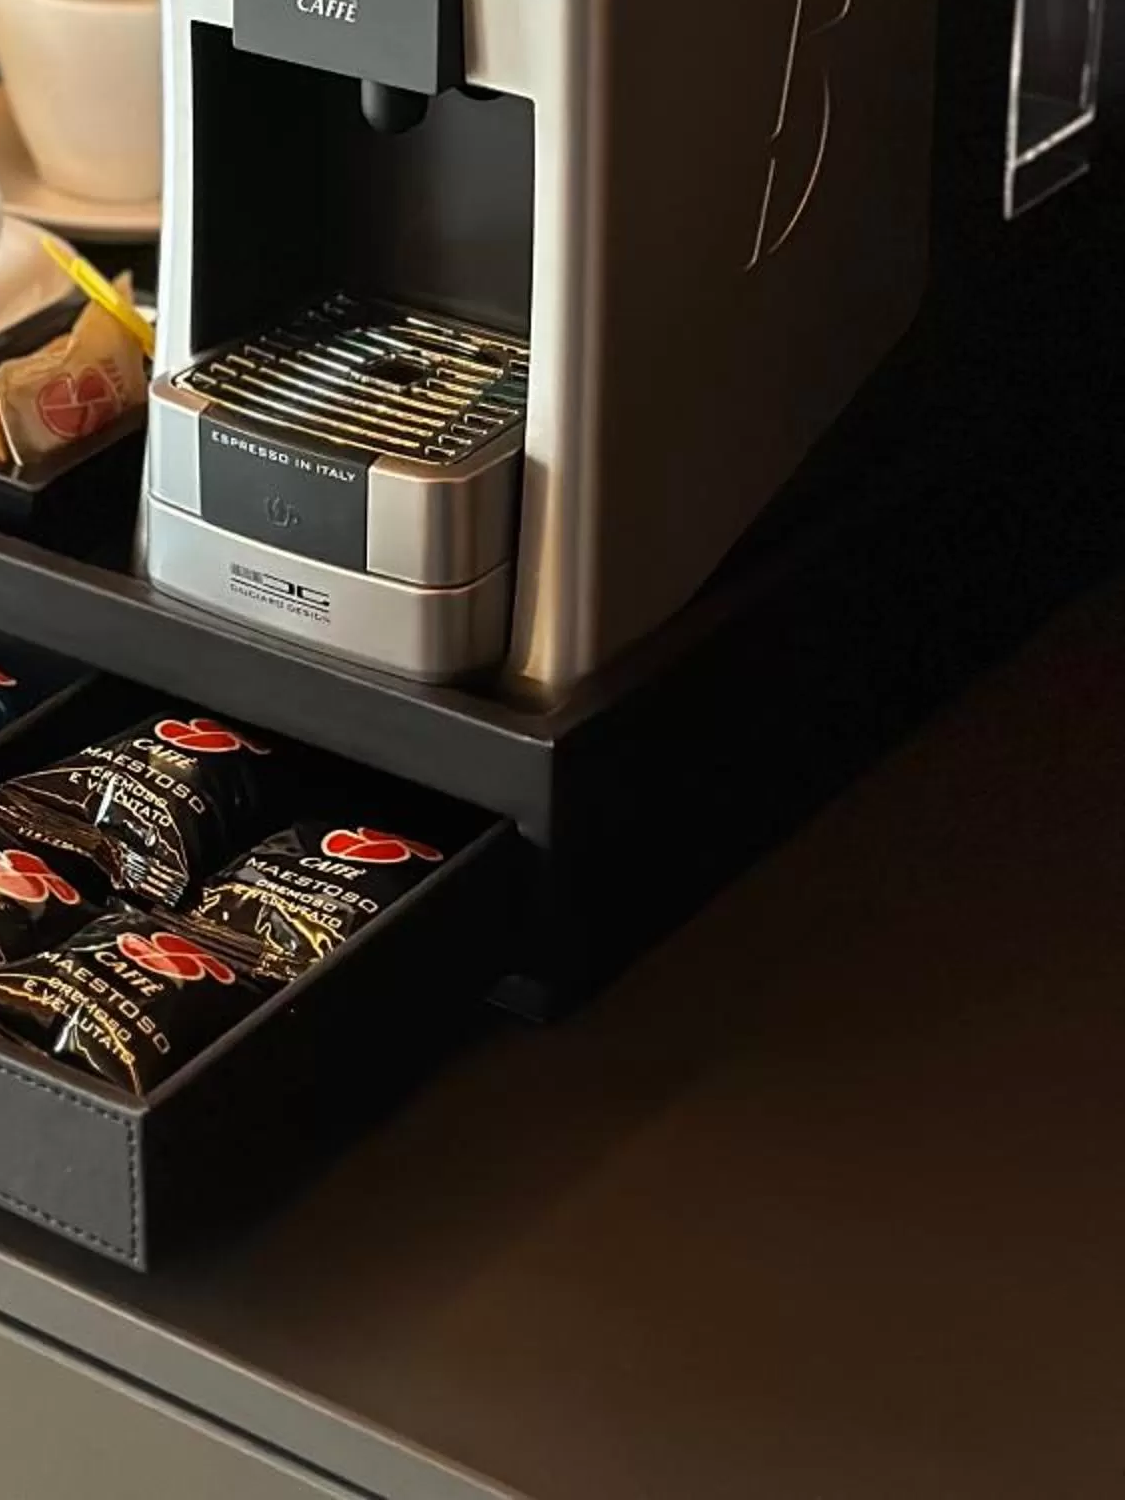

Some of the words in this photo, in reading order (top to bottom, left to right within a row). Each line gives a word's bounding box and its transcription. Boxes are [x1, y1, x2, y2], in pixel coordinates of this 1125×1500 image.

[211, 430, 289, 465] ESPRESSO
[295, 458, 311, 472] IN
[316, 464, 356, 483] ITALY
[79, 745, 207, 815] MAESTOSO
[244, 856, 380, 914] MAESTOSO
[36, 950, 172, 1056] MAESTOSO
[39, 988, 137, 1066] VELUTATO
